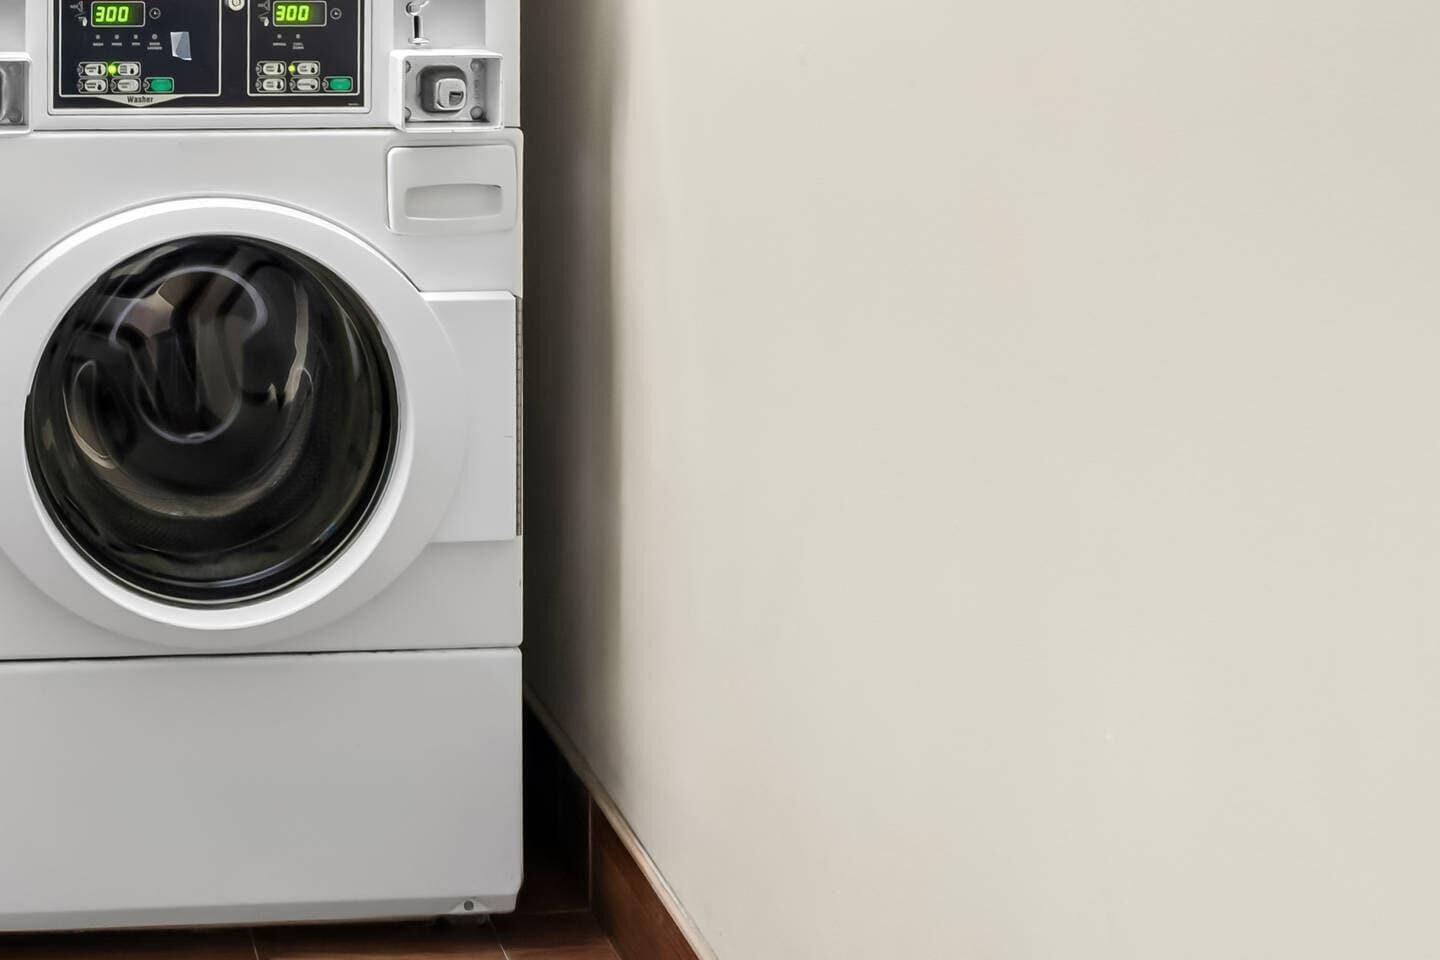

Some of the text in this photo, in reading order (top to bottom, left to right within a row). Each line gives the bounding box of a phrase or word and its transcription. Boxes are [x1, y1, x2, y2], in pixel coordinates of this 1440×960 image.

[95, 6, 130, 23] 300
[276, 5, 310, 22] 300
[126, 95, 154, 104] Washer
